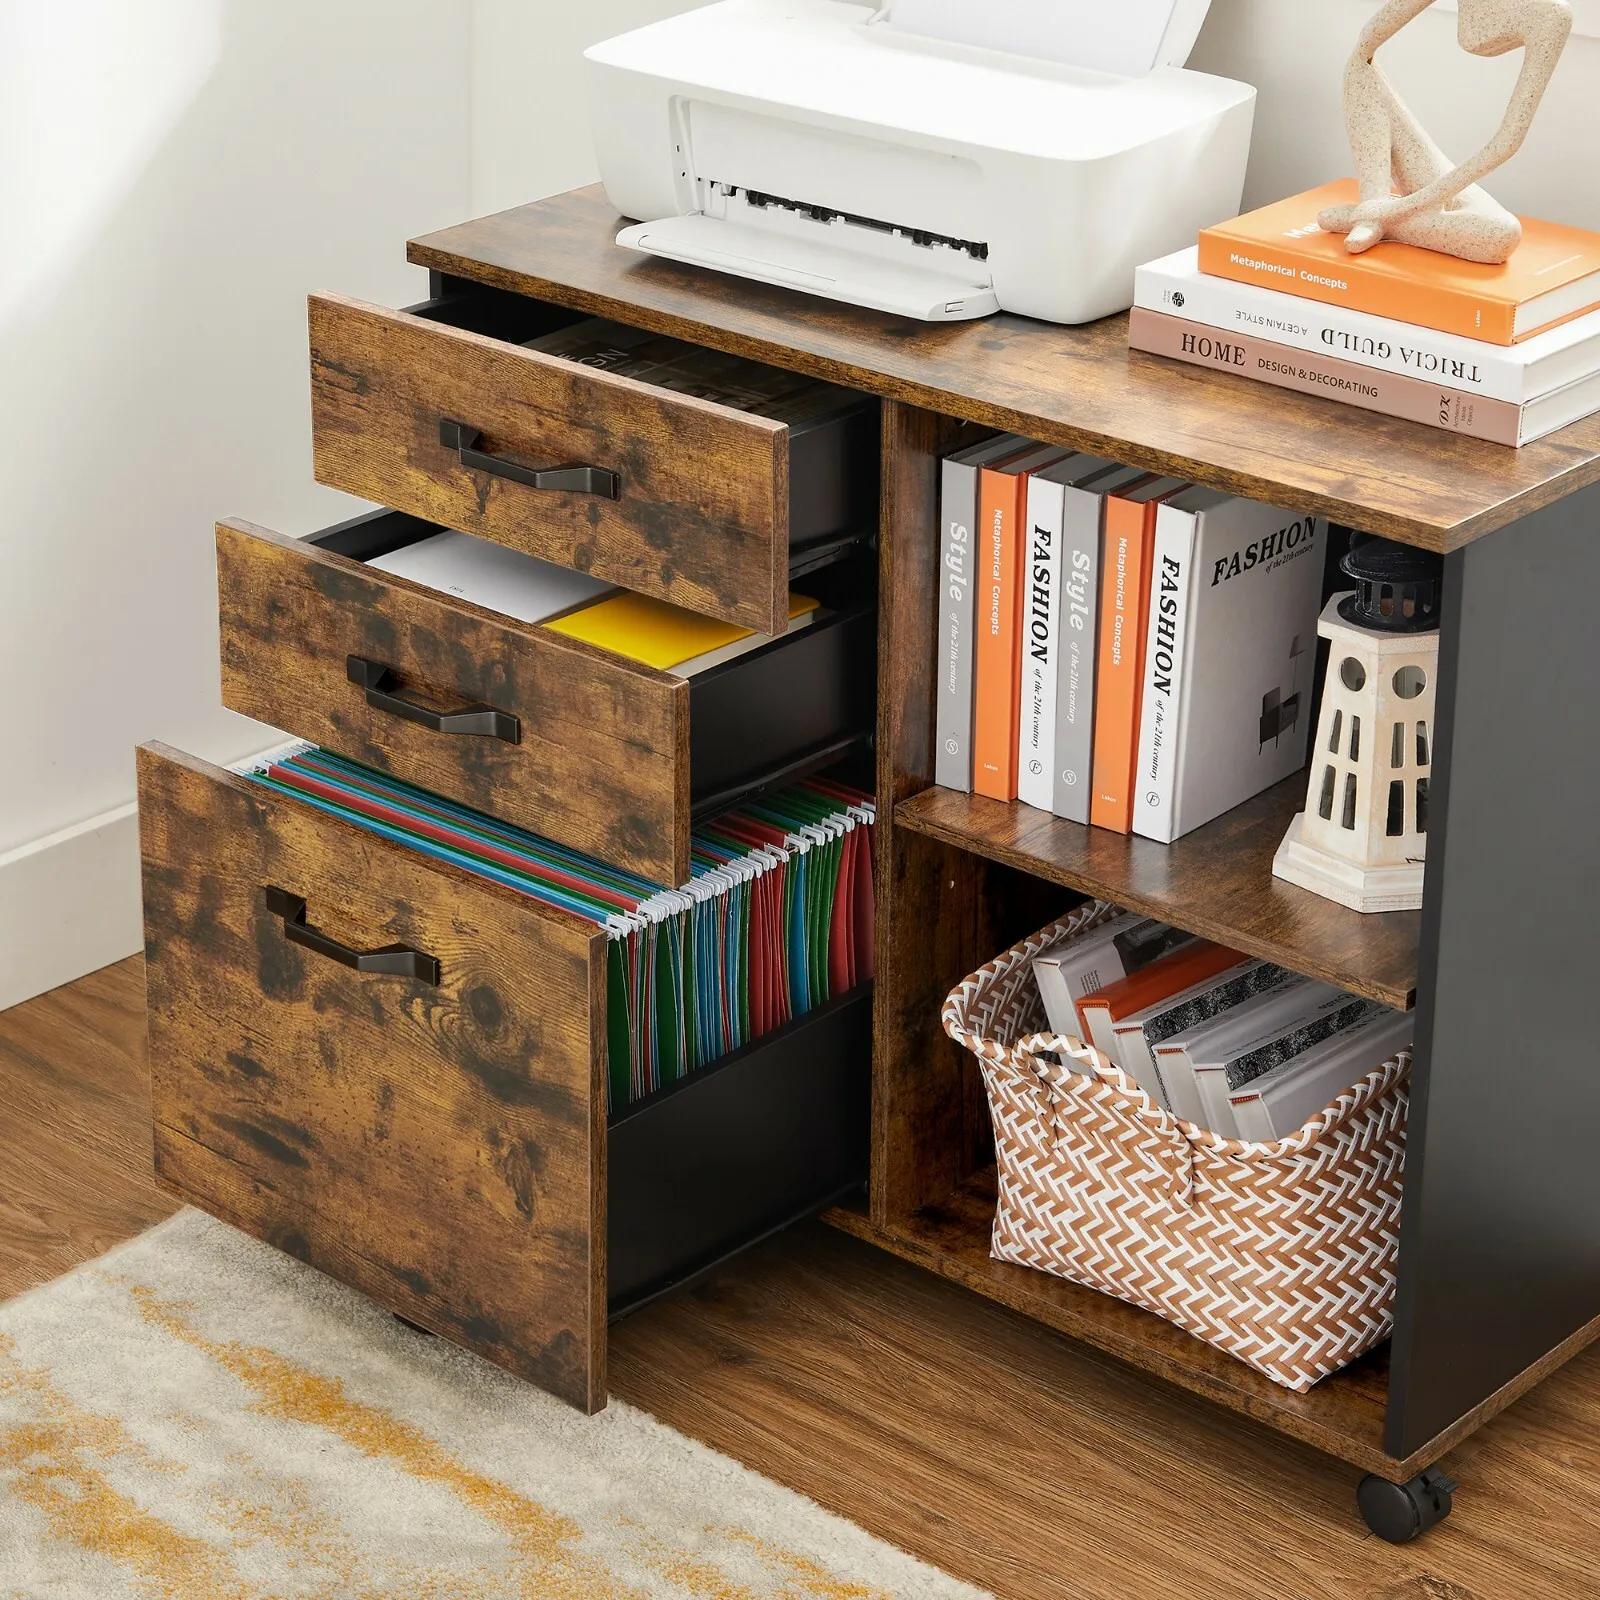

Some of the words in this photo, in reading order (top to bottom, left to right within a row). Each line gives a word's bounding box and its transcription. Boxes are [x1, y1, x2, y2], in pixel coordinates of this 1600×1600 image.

[1230, 253, 1296, 278] Metaphorical
[1300, 270, 1348, 290] Concepts
[1235, 310, 1264, 326] STYLE
[1266, 318, 1300, 334] CETAIN
[1301, 328, 1308, 336] A
[1321, 328, 1392, 359] GUILD
[1181, 332, 1246, 367] HOME
[1258, 358, 1296, 377] DESIGN
[1298, 368, 1308, 380] &
[1309, 371, 1378, 398] DECORATING
[1400, 346, 1482, 383] TRICIA
[946, 522, 968, 601] Style
[992, 509, 1002, 582] Metaphorical
[1211, 516, 1316, 587] FASHION
[1265, 564, 1273, 574] of
[1273, 558, 1282, 569] the
[1294, 543, 1314, 560] century
[1066, 550, 1090, 631] Style
[1115, 537, 1128, 611] Metaphorical
[990, 586, 1000, 635] Concepts
[1030, 524, 1051, 665] FASHION
[950, 612, 959, 625] of
[951, 626, 959, 638] the
[1153, 554, 1180, 696] FASHION
[1069, 642, 1080, 654] of
[1112, 614, 1124, 665] Concepts
[948, 661, 958, 693] century
[1033, 668, 1042, 680] of
[1070, 655, 1080, 668] the
[1034, 680, 1042, 695] the
[1067, 691, 1076, 724] century
[1155, 700, 1164, 712] of
[1031, 716, 1040, 749] century
[1150, 747, 1159, 781] century
